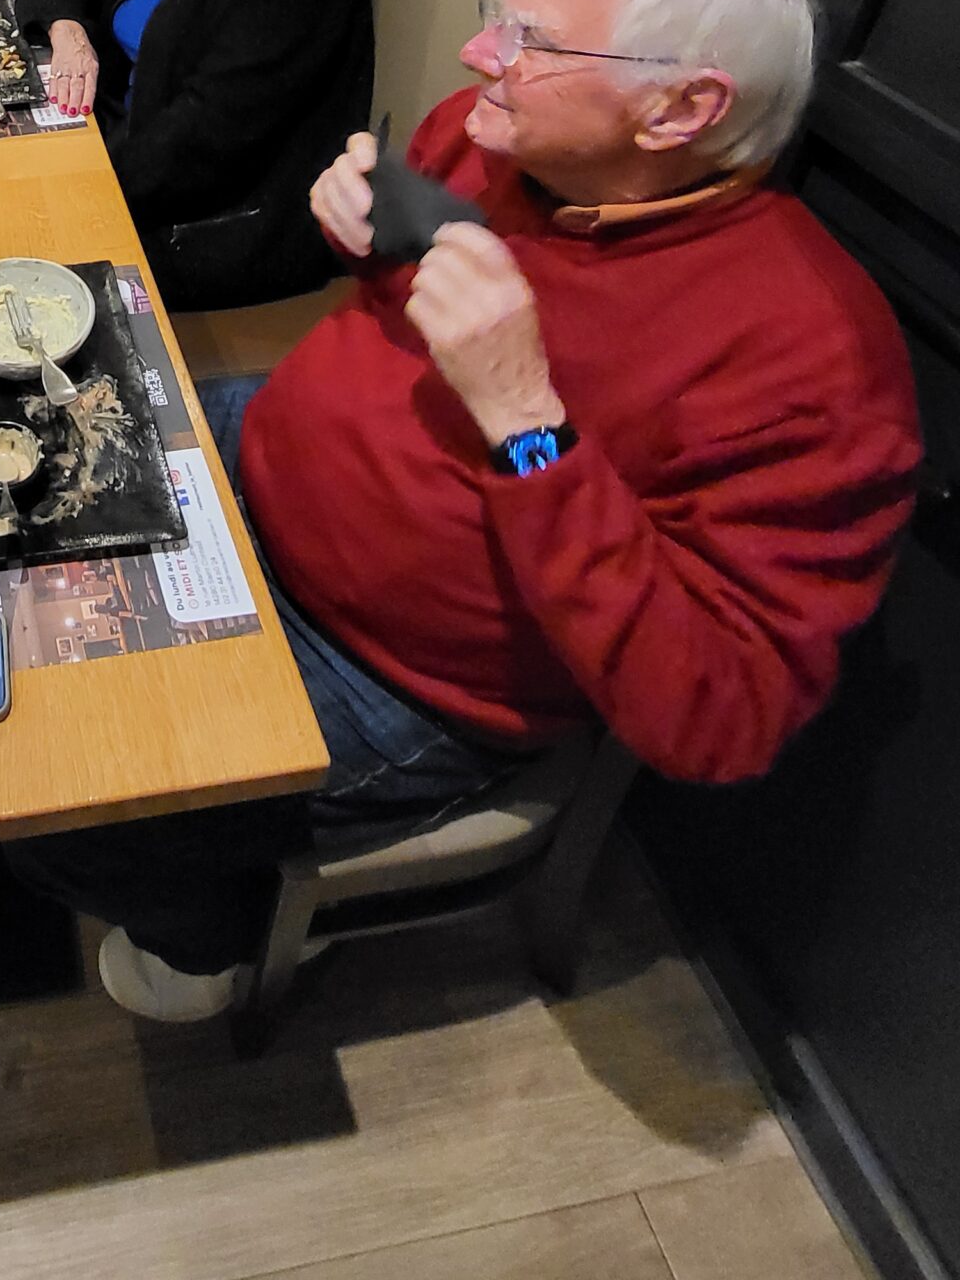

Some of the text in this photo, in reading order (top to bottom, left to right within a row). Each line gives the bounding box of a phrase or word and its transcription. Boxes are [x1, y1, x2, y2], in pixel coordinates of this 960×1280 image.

[177, 559, 187, 570] ET
[167, 561, 184, 611] Du lundi au
[182, 573, 195, 597] MIDI
